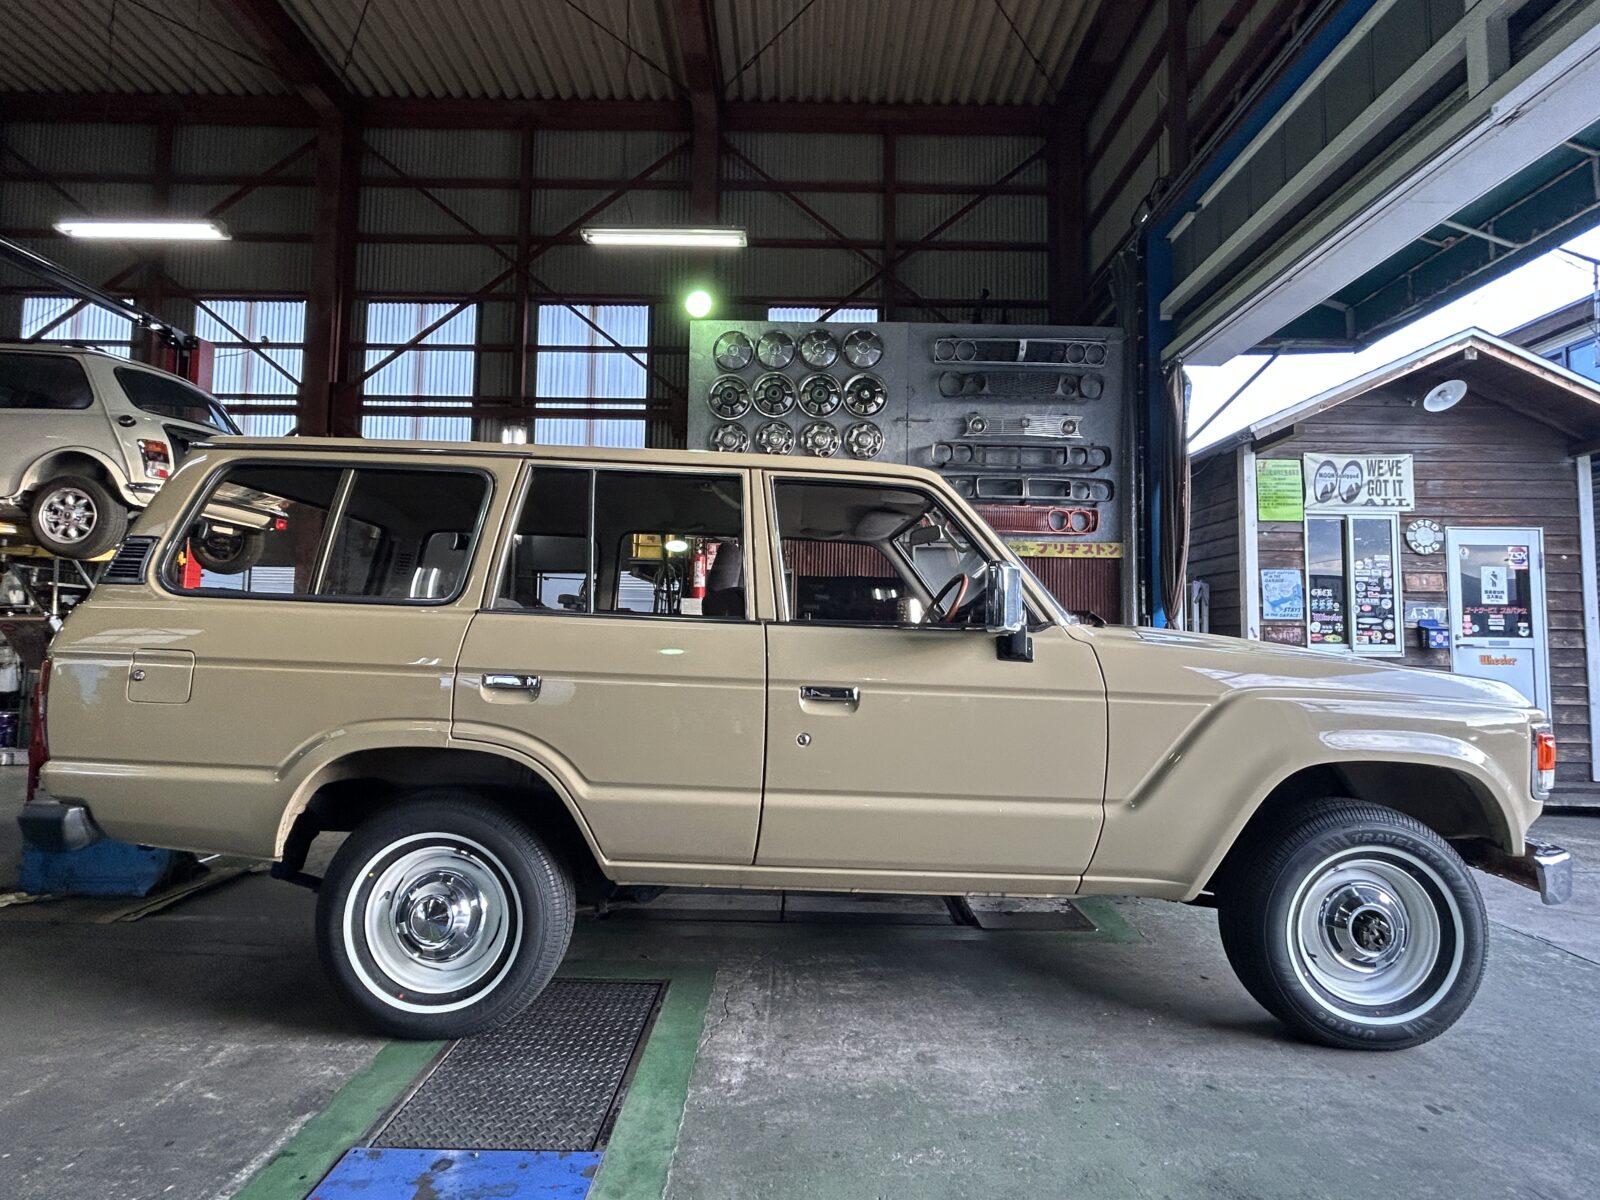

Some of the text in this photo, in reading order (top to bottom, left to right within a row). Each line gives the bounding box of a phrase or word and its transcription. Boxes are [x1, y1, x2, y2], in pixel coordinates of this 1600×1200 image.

[1366, 459, 1402, 477] WE'VE
[1367, 480, 1403, 497] GOT IT
[1360, 498, 1410, 507] ALL
[1410, 519, 1440, 532] USED
[1036, 543, 1120, 554] ブリヂストン
[1411, 541, 1440, 554] CARS
[1478, 654, 1518, 666] Wheeler
